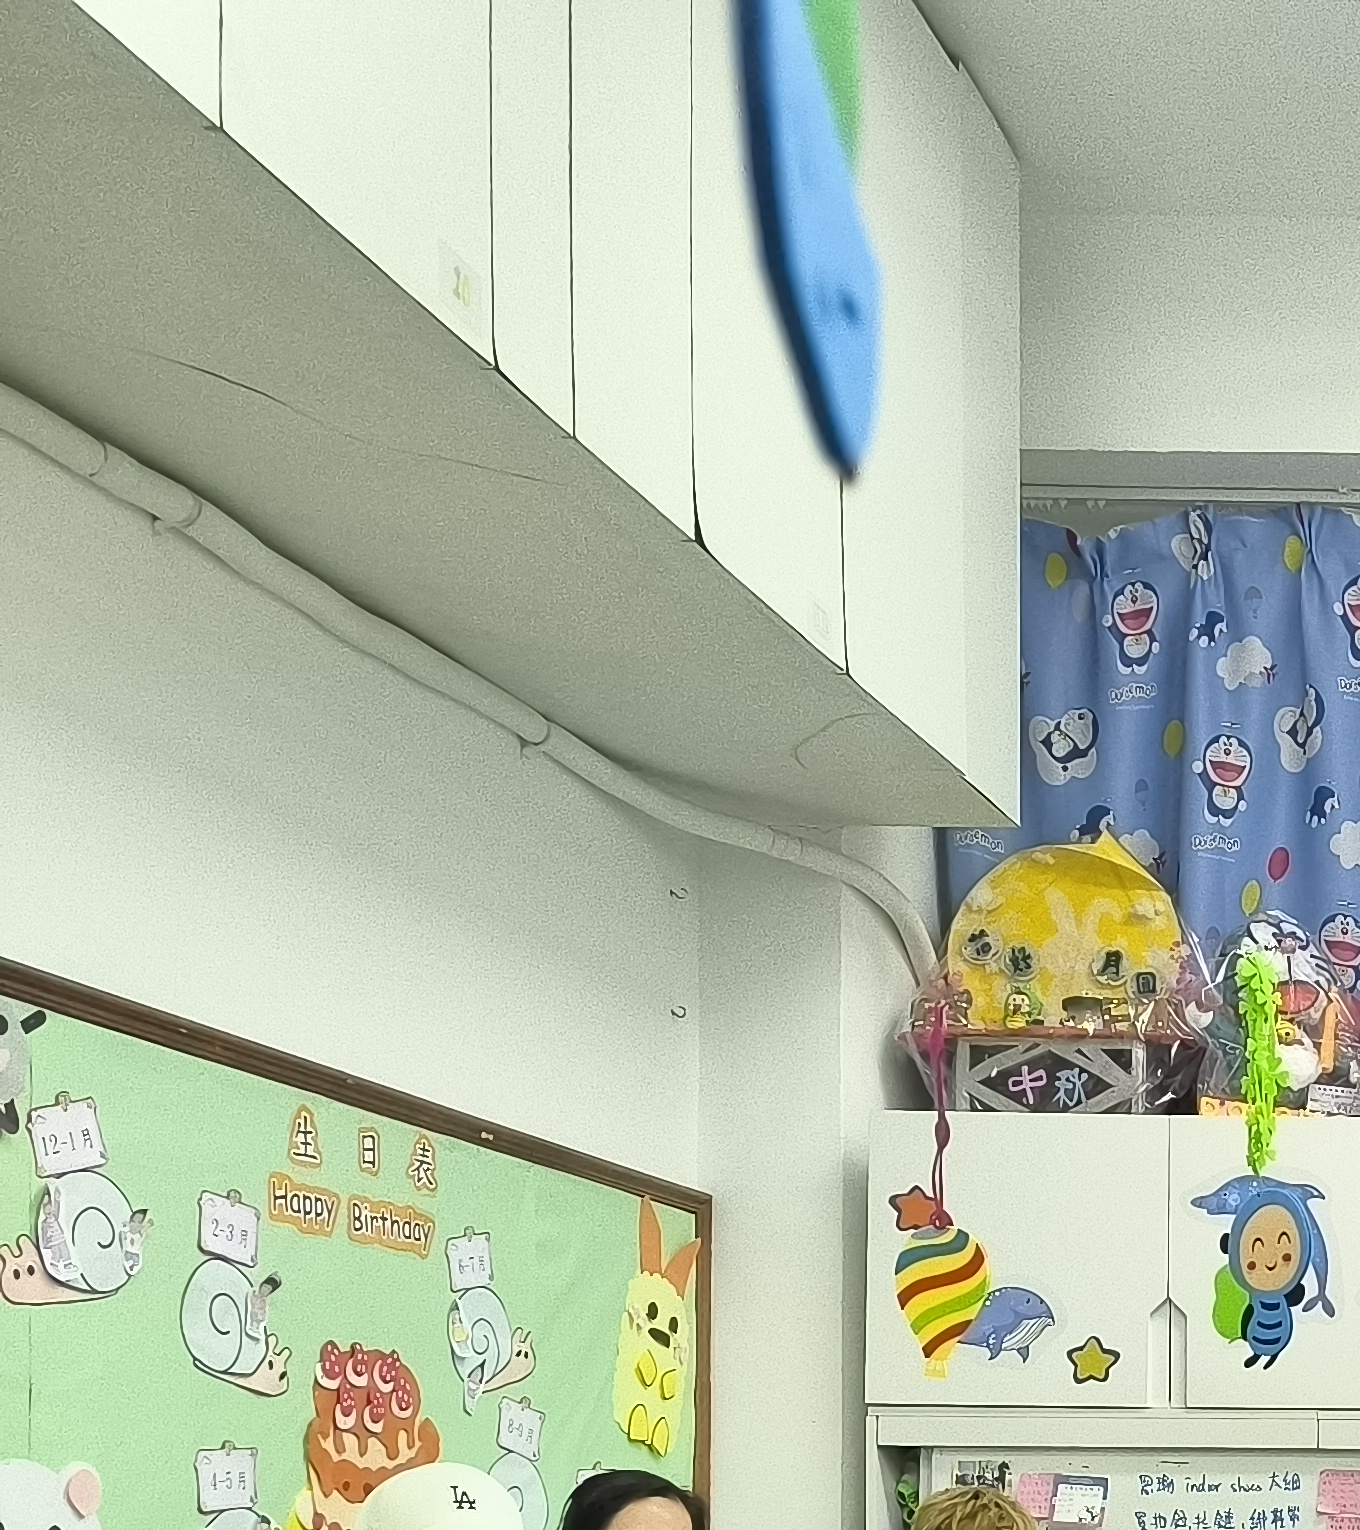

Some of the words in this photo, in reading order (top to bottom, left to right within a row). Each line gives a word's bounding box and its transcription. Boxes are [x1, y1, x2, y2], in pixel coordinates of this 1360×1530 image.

[1008, 1065, 1088, 1108] 中秋
[41, 1127, 94, 1157] 12-1月
[292, 1113, 434, 1187] 生日表
[270, 1179, 336, 1231] Happy
[351, 1201, 432, 1254] Birthday
[450, 1485, 477, 1510] LA
